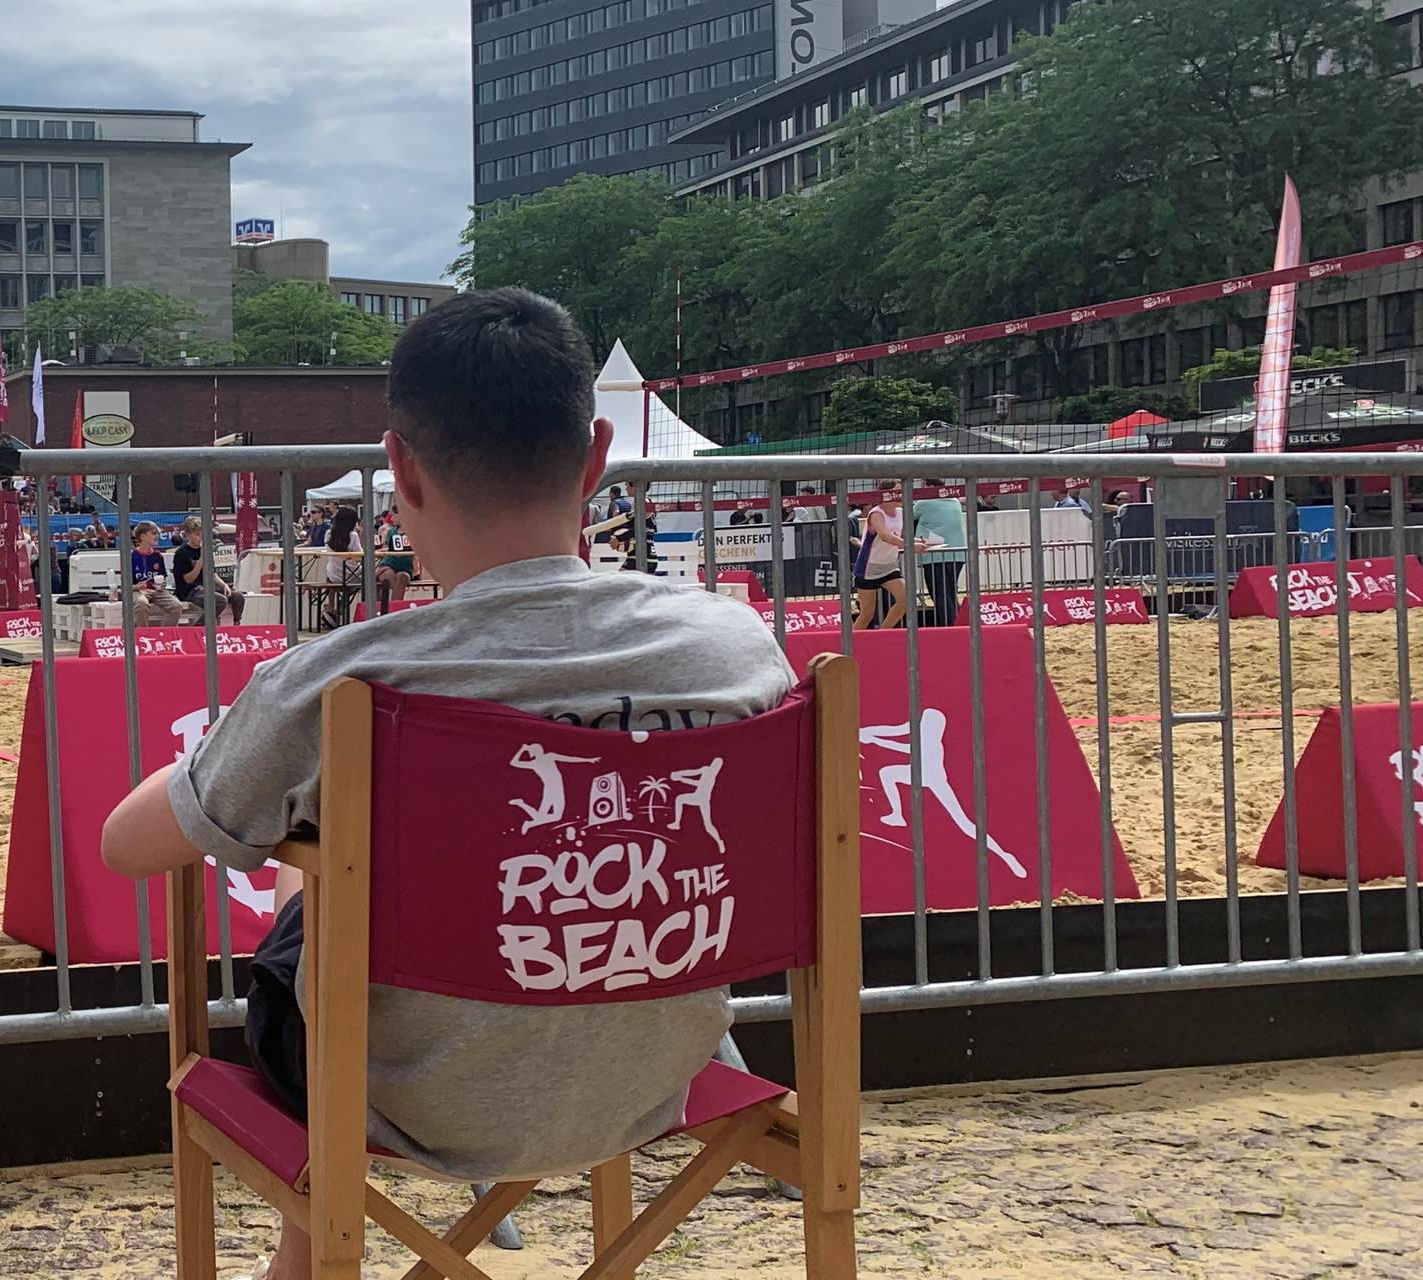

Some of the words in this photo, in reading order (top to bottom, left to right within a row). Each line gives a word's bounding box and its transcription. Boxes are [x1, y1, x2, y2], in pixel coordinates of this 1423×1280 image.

[1290, 373, 1345, 395] ECK'S
[1288, 432, 1341, 444] BECK'S
[395, 537, 401, 549] 6
[726, 532, 785, 546] PERFEKTS
[1067, 606, 1095, 619] BEAC
[6, 617, 31, 630] ROCK
[498, 838, 670, 916] ROCK
[674, 863, 730, 902] THE
[496, 896, 736, 993] BEACH
